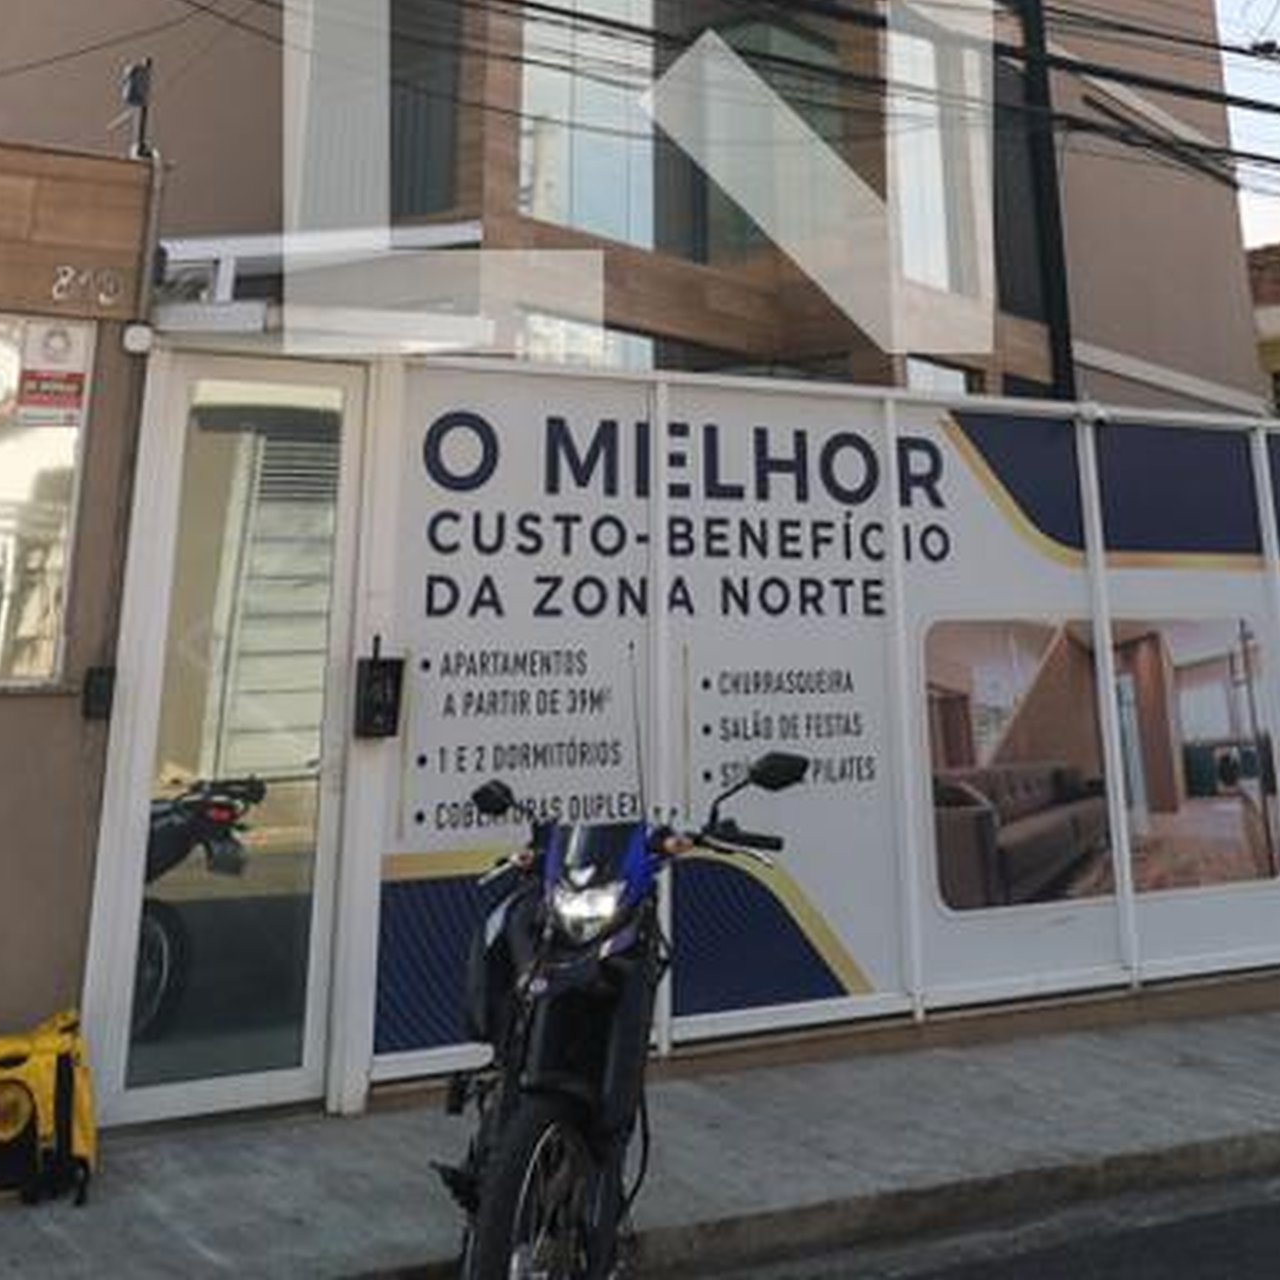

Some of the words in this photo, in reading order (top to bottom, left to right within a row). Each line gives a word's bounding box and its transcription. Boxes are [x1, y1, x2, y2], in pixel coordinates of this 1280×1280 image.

[423, 410, 499, 493] O
[545, 415, 947, 509] MELHOR
[427, 510, 951, 563] CUSTO-BENEFÍCIO
[426, 574, 505, 618] DA
[533, 575, 695, 618] ZONA
[721, 575, 886, 617] NORTE
[440, 649, 589, 679] APARTAMENTOS
[719, 669, 855, 696] CHURRASQUEIRA
[443, 692, 457, 718] A
[462, 689, 532, 717] PARTIR
[535, 688, 563, 716] DE
[720, 709, 773, 742] SALÃO
[778, 714, 800, 740] DE
[805, 711, 863, 739] FESTAS
[438, 746, 446, 773] 1
[455, 745, 469, 772] E
[474, 746, 487, 772] 2
[492, 736, 622, 772] DORMITÓRIOS
[812, 755, 876, 784] PILATES
